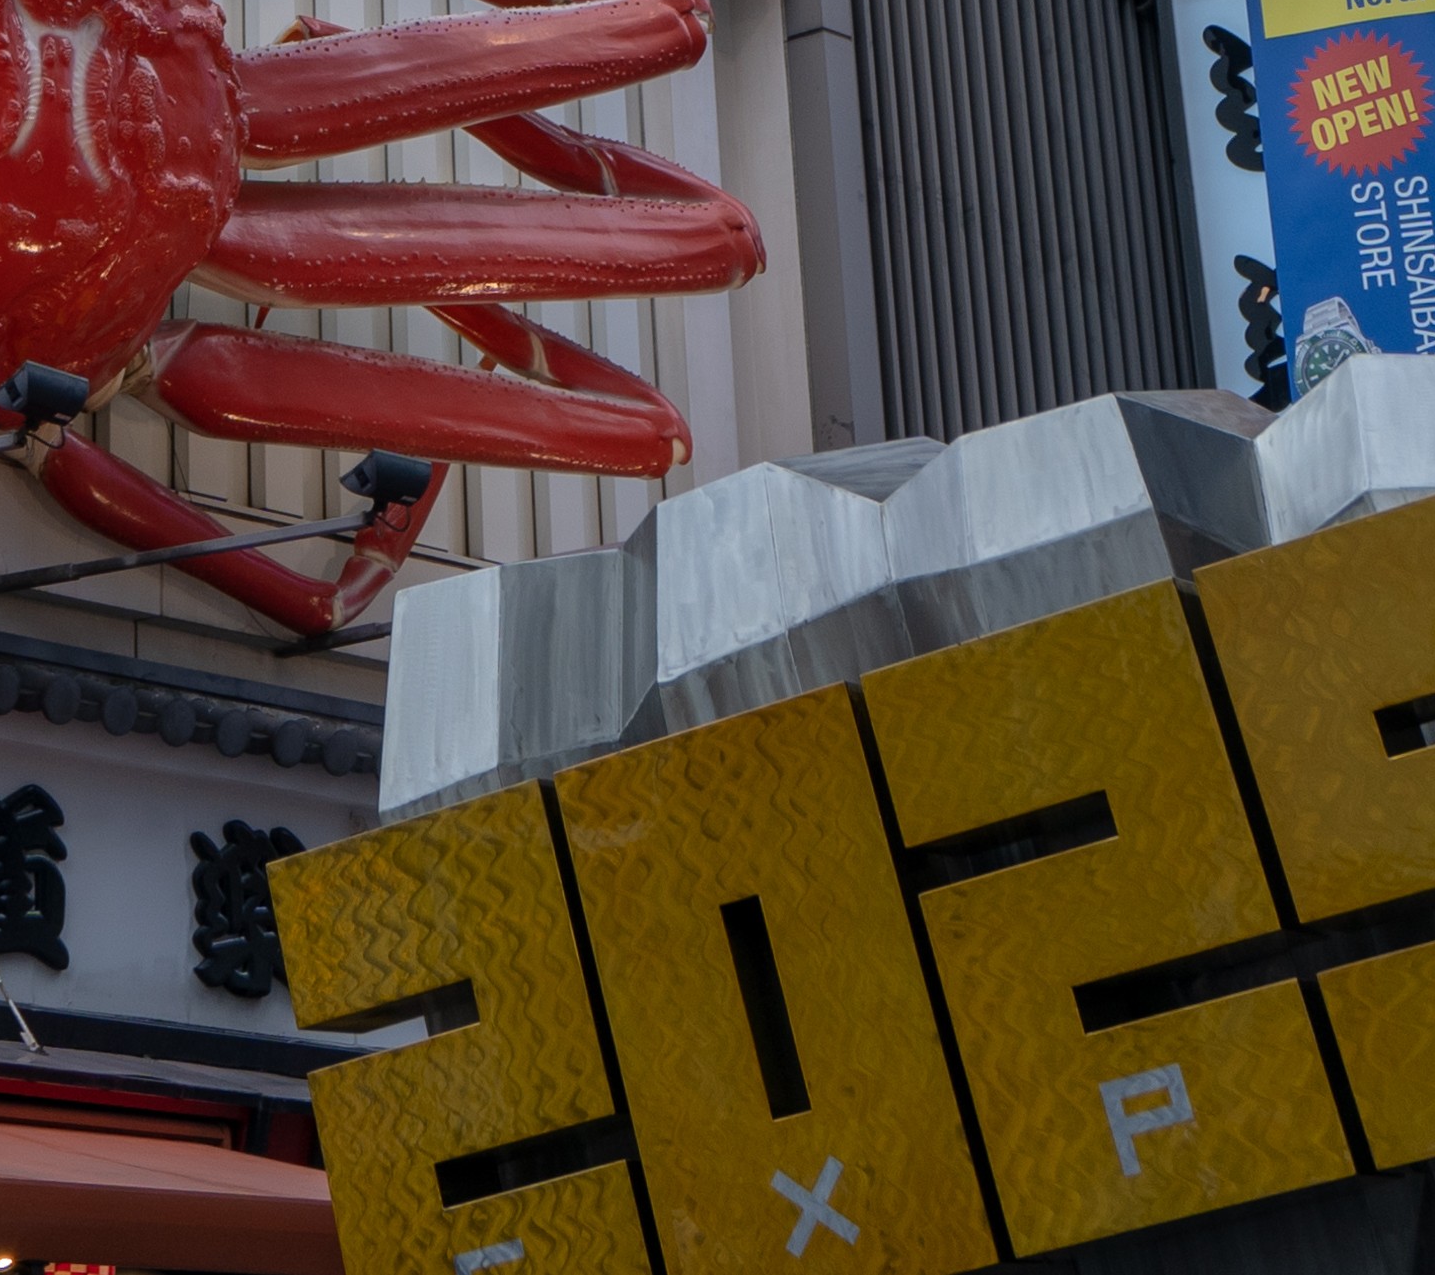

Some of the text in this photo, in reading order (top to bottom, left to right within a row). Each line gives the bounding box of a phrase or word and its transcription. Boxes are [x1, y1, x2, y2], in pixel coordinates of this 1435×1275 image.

[1311, 55, 1393, 112] NEW
[1310, 90, 1420, 152] OPEN!
[1351, 181, 1396, 291] STORE
